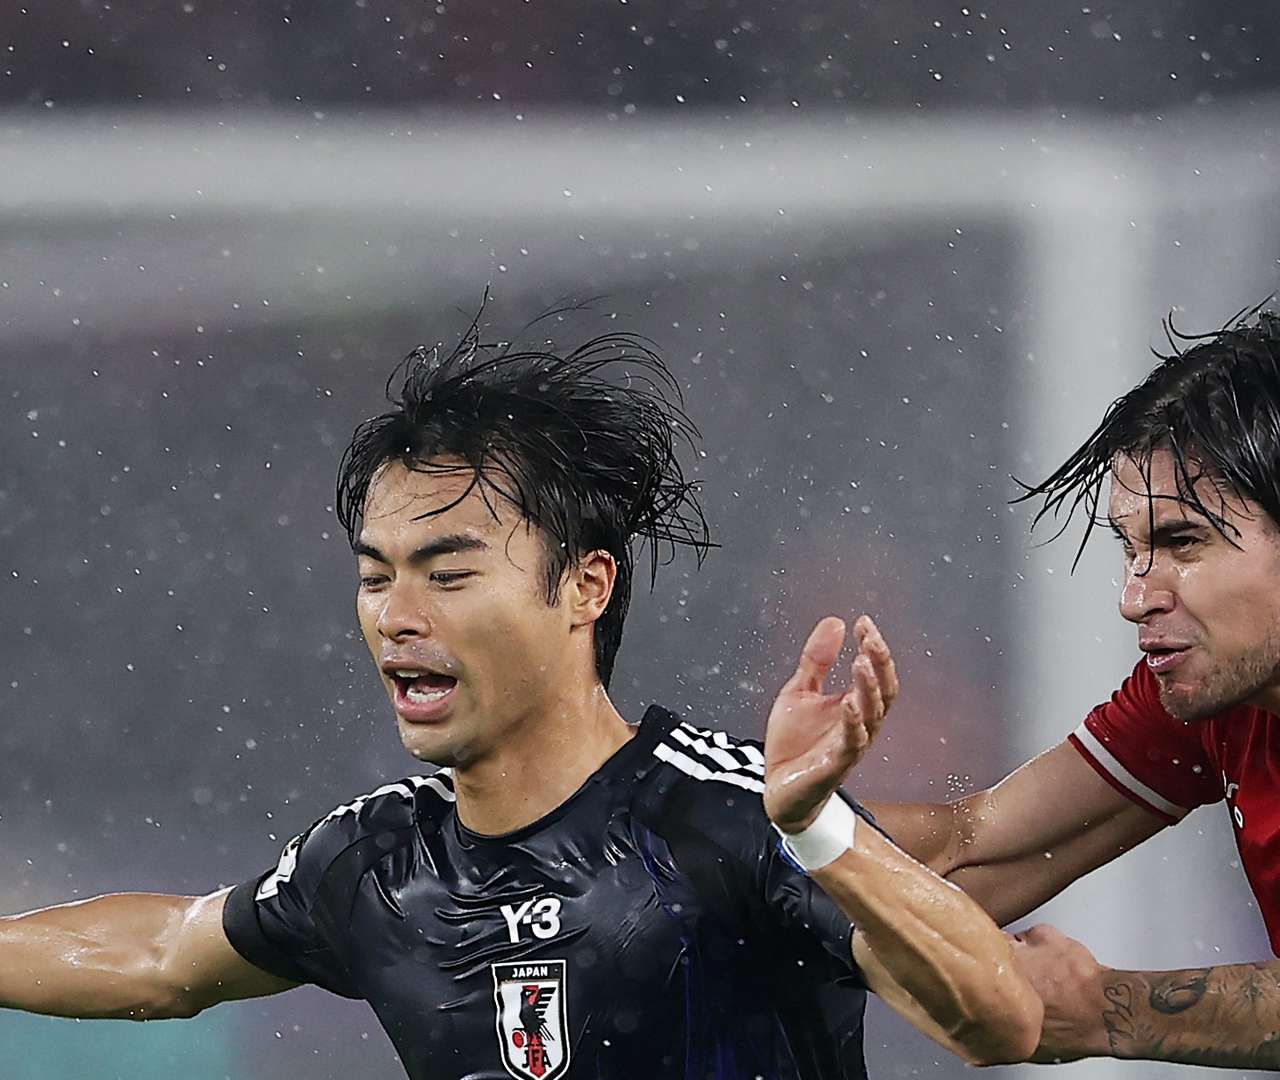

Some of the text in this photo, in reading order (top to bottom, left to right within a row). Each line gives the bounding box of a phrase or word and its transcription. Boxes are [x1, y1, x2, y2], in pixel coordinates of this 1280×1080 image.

[500, 897, 562, 943] Y-3
[511, 966, 548, 978] JAPAN
[522, 1050, 552, 1069] JFA
